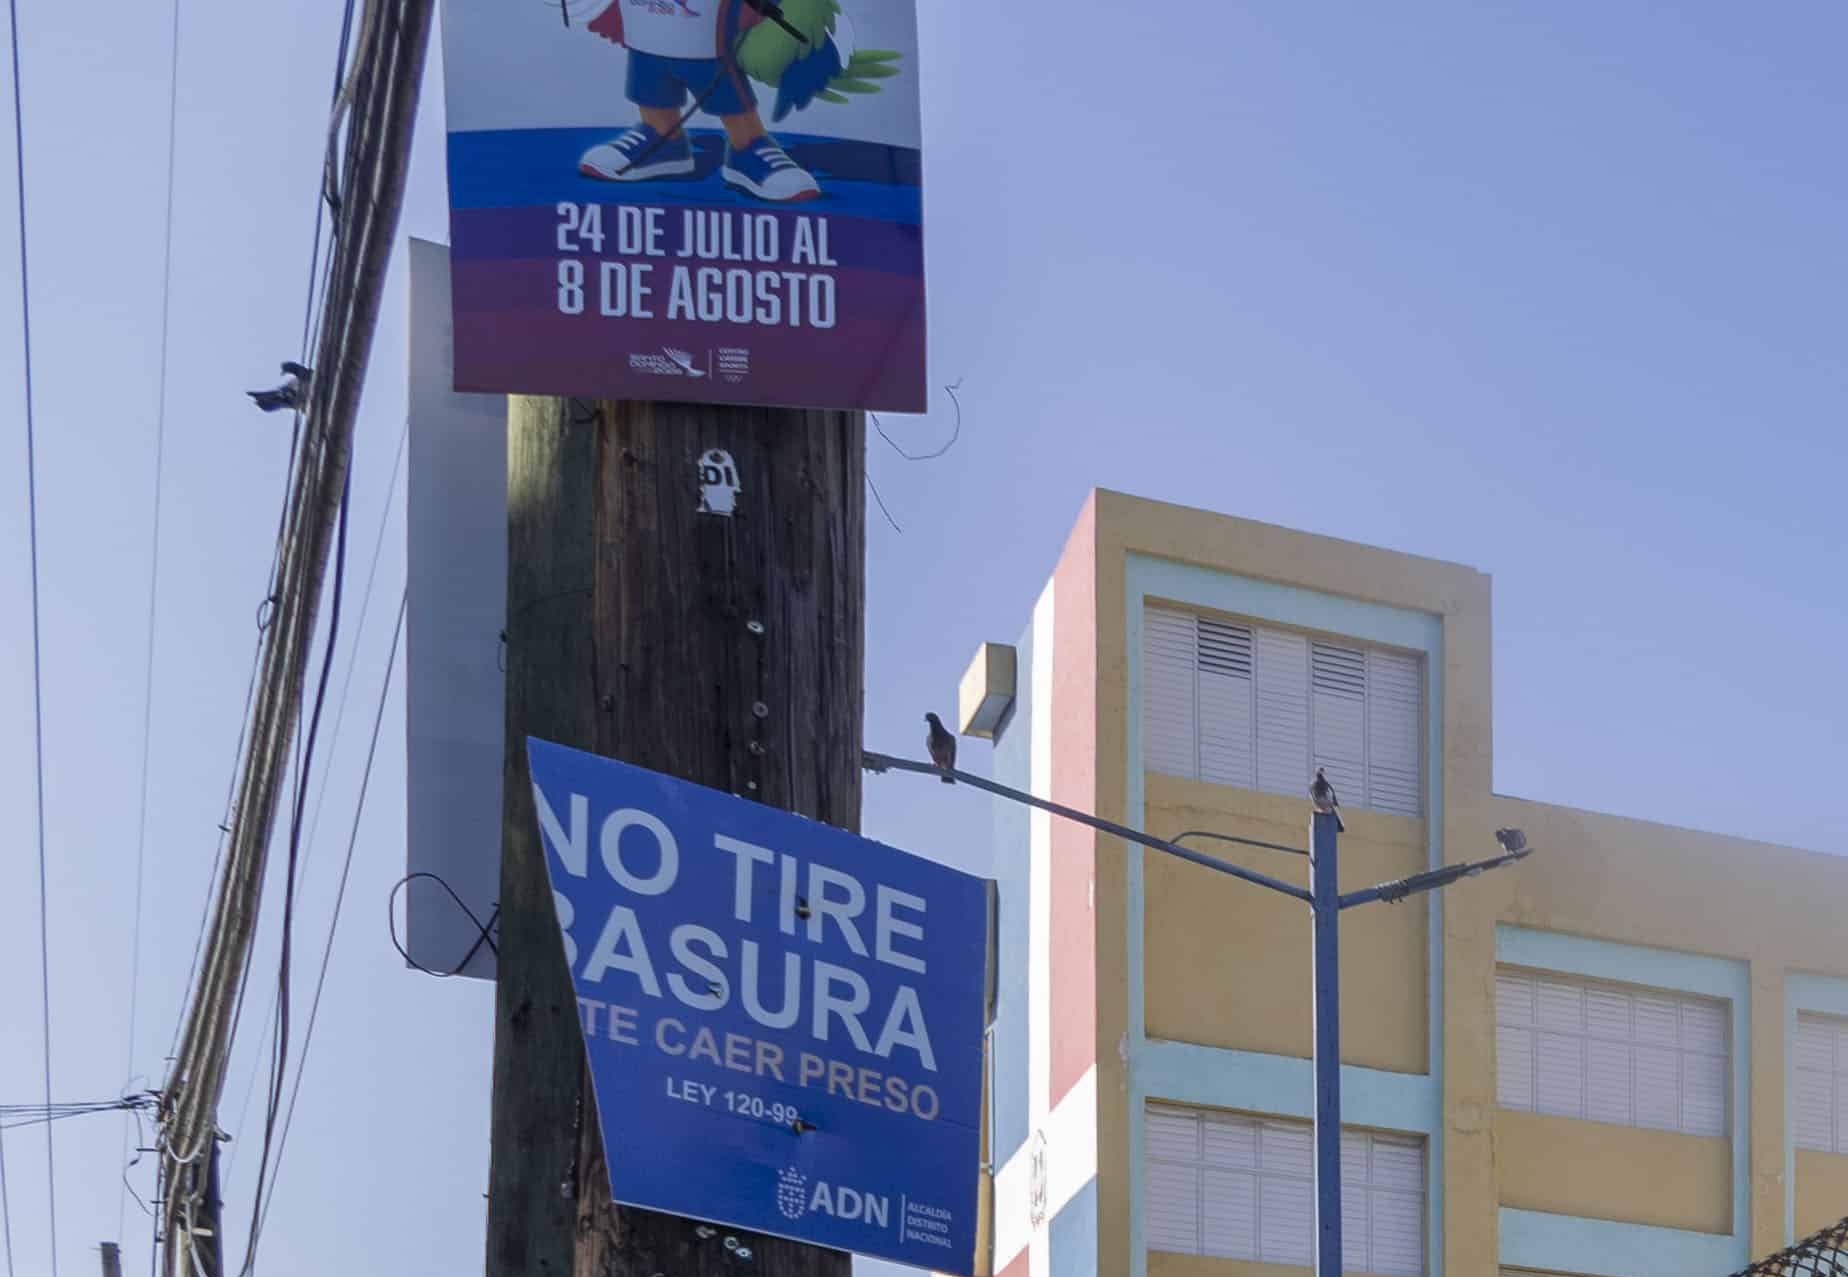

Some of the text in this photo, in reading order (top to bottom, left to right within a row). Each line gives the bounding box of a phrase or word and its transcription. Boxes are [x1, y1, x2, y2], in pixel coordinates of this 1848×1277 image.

[557, 202, 838, 267] 24 DE JULIO AL
[556, 260, 837, 329] 8 DE AGOSTO
[532, 783, 927, 975] NO TIRE
[655, 1017, 785, 1081] CAER
[800, 1053, 940, 1122] PRESO
[666, 1076, 801, 1129] LEY 120-99
[809, 1181, 889, 1228] ADN
